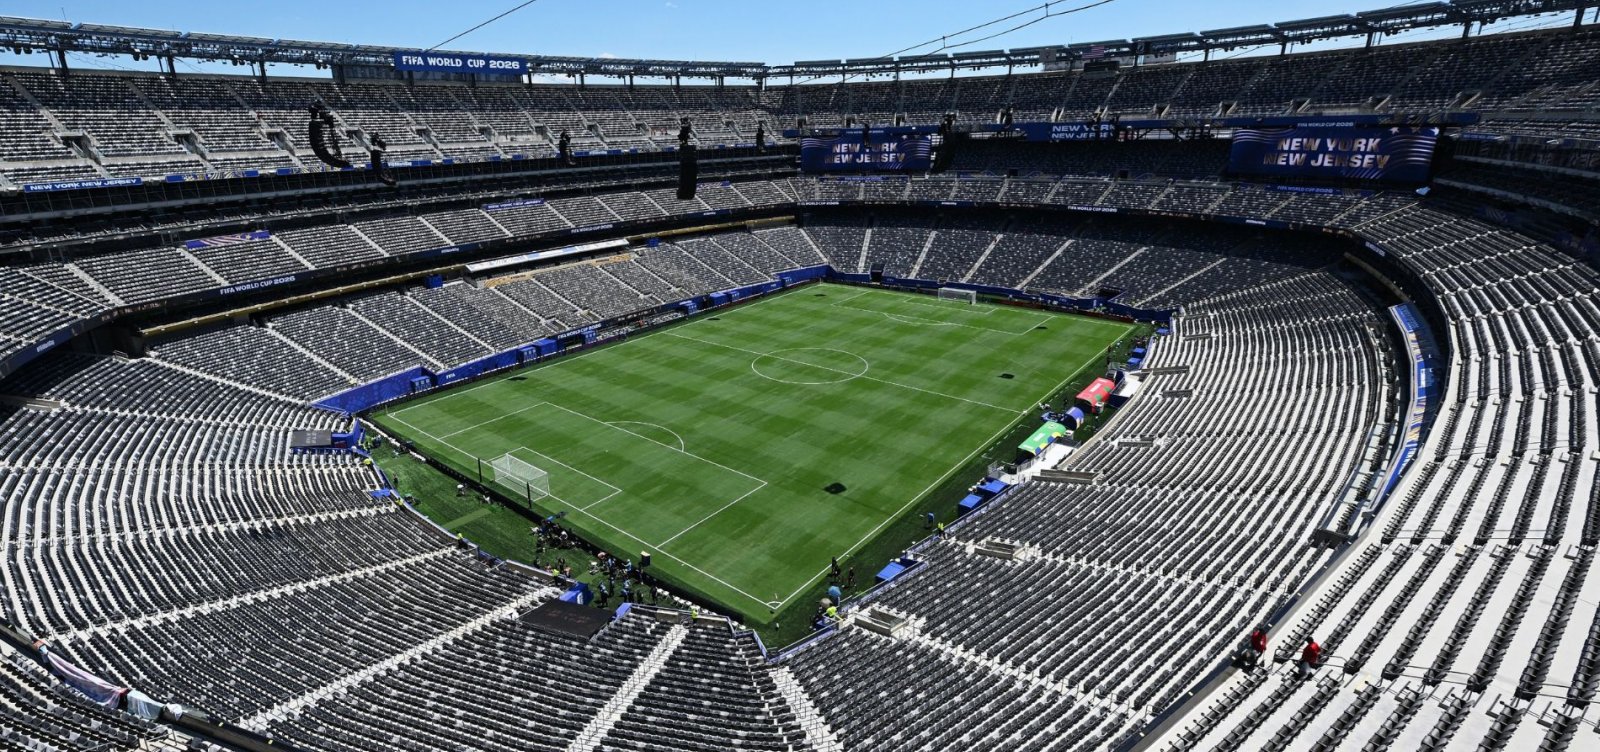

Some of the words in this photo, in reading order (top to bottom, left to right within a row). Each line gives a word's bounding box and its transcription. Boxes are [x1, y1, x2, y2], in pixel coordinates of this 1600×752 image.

[402, 55, 425, 66] FIFA
[427, 56, 462, 67] WORLD
[467, 58, 485, 68] CUP
[489, 59, 520, 69] 2026
[1052, 124, 1080, 132] NEW
[832, 143, 860, 153] NEW
[1277, 138, 1321, 151] NEW
[1326, 138, 1381, 152] YORK
[824, 153, 852, 164] NEW
[856, 153, 905, 163] JERSEY
[1263, 153, 1307, 166] NEW
[1310, 153, 1390, 168] JERSEY
[220, 287, 236, 295] FIFA
[234, 282, 260, 292] WORLD
[273, 275, 296, 285] 2026
